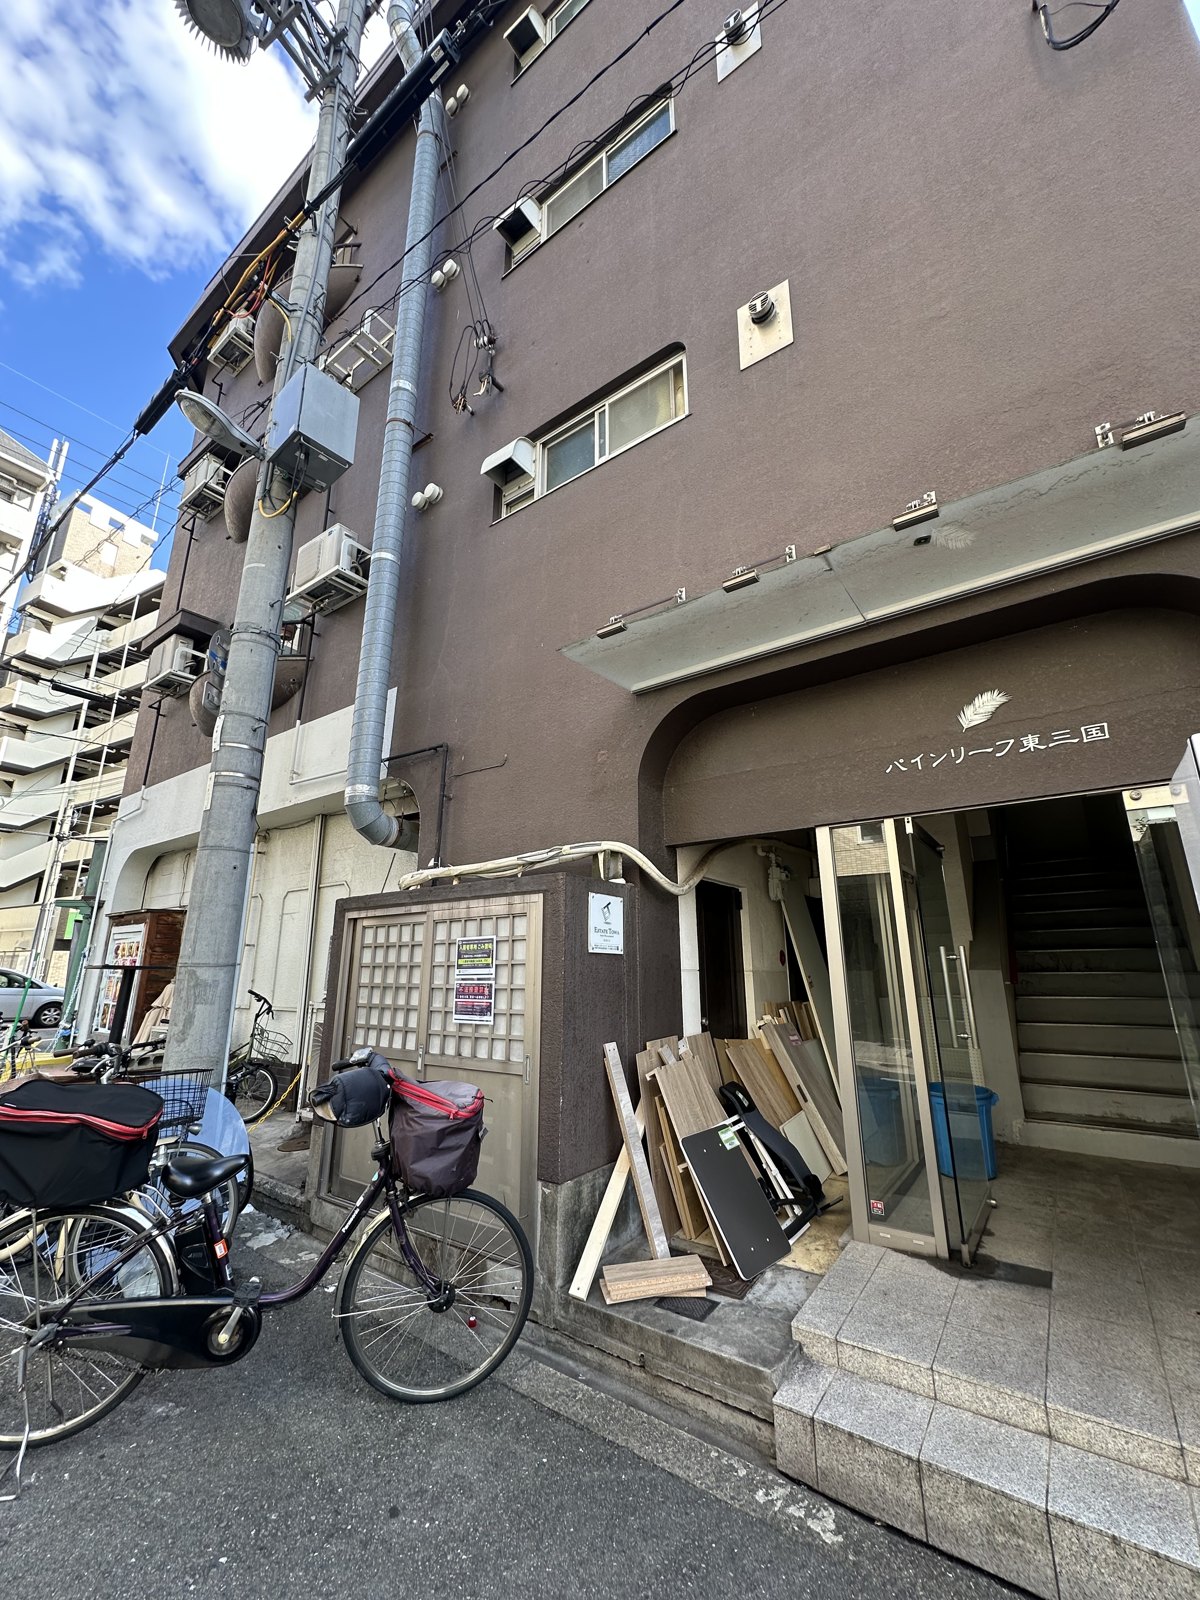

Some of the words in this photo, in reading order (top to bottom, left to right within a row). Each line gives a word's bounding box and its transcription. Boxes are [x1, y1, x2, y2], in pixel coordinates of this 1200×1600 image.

[885, 722, 1110, 774] パインリーフ東三国
